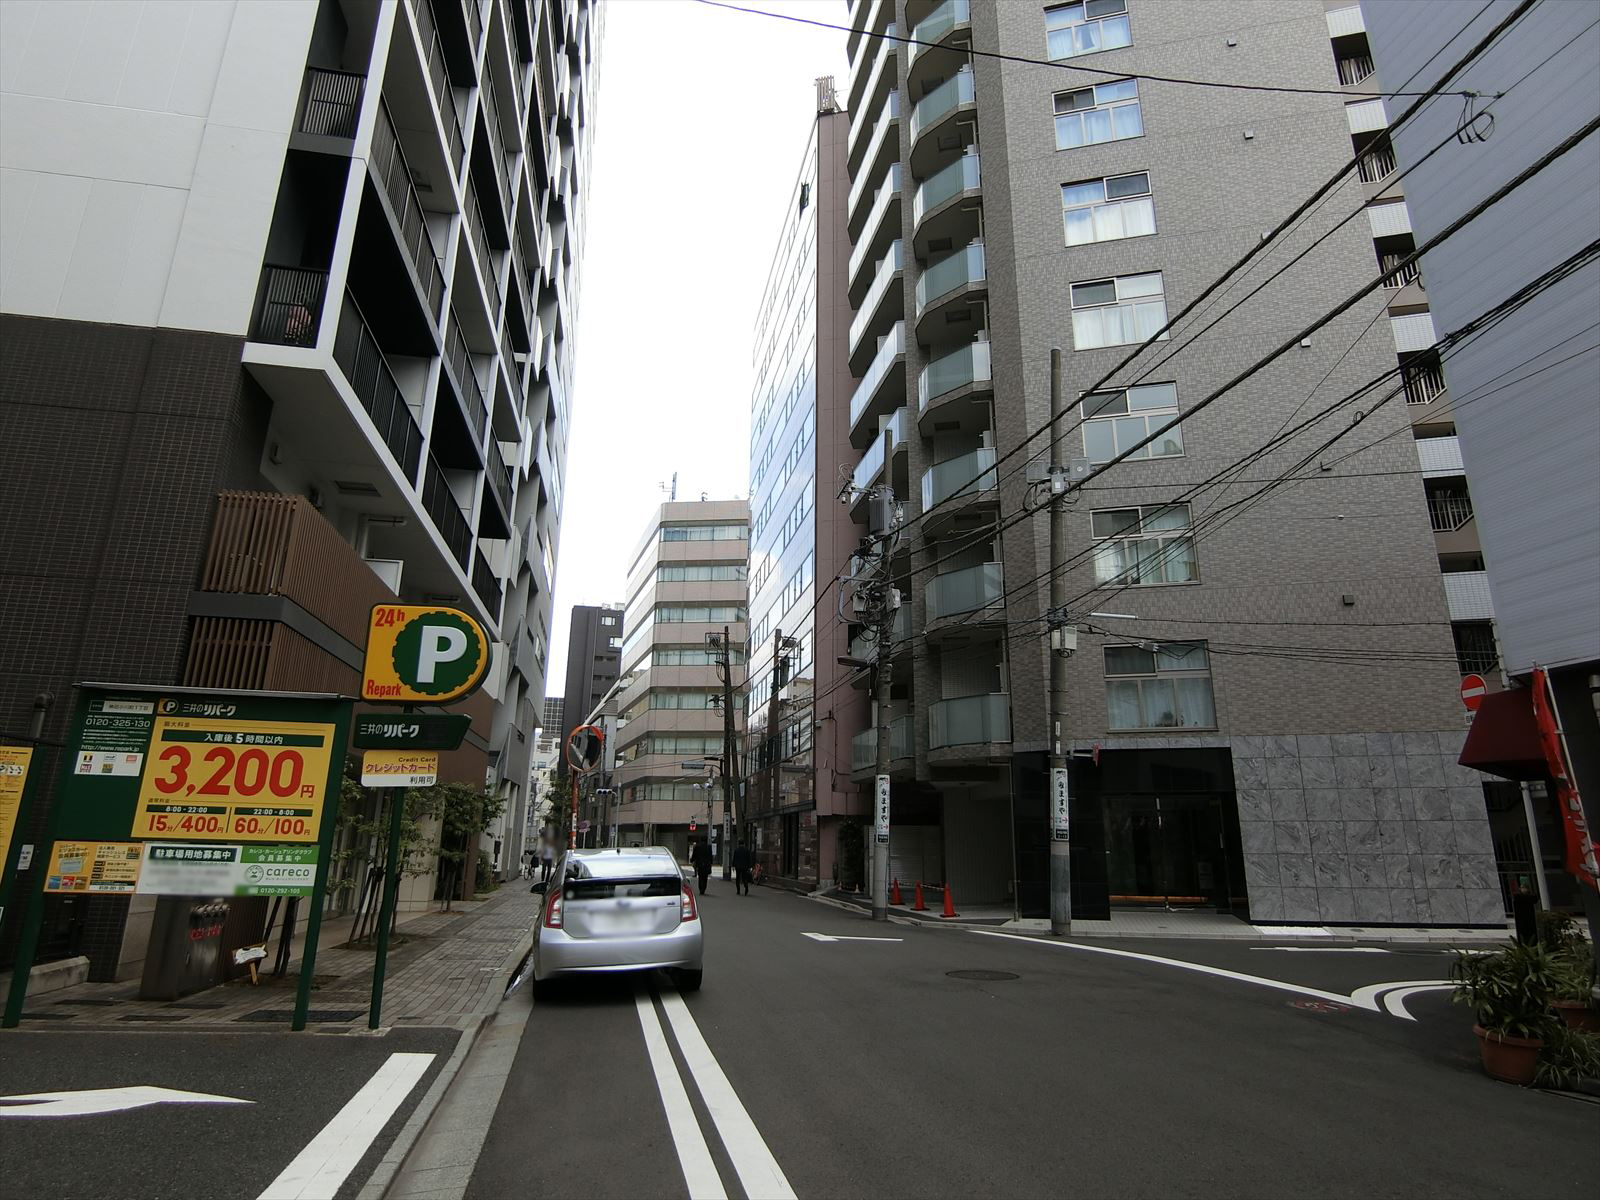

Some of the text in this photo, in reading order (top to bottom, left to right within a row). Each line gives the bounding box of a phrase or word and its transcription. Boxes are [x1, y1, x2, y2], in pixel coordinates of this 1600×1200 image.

[375, 608, 405, 627] 24h
[416, 625, 468, 683] P
[366, 679, 402, 697] Repark
[183, 703, 236, 716] 三井のリパーク
[86, 718, 150, 727] 0120-325-130
[360, 723, 420, 737] 三井のリパーク
[366, 763, 435, 773] クレジットカード
[409, 775, 434, 785] 利用可
[258, 854, 302, 862] 会員募集中
[266, 868, 310, 877] careco
